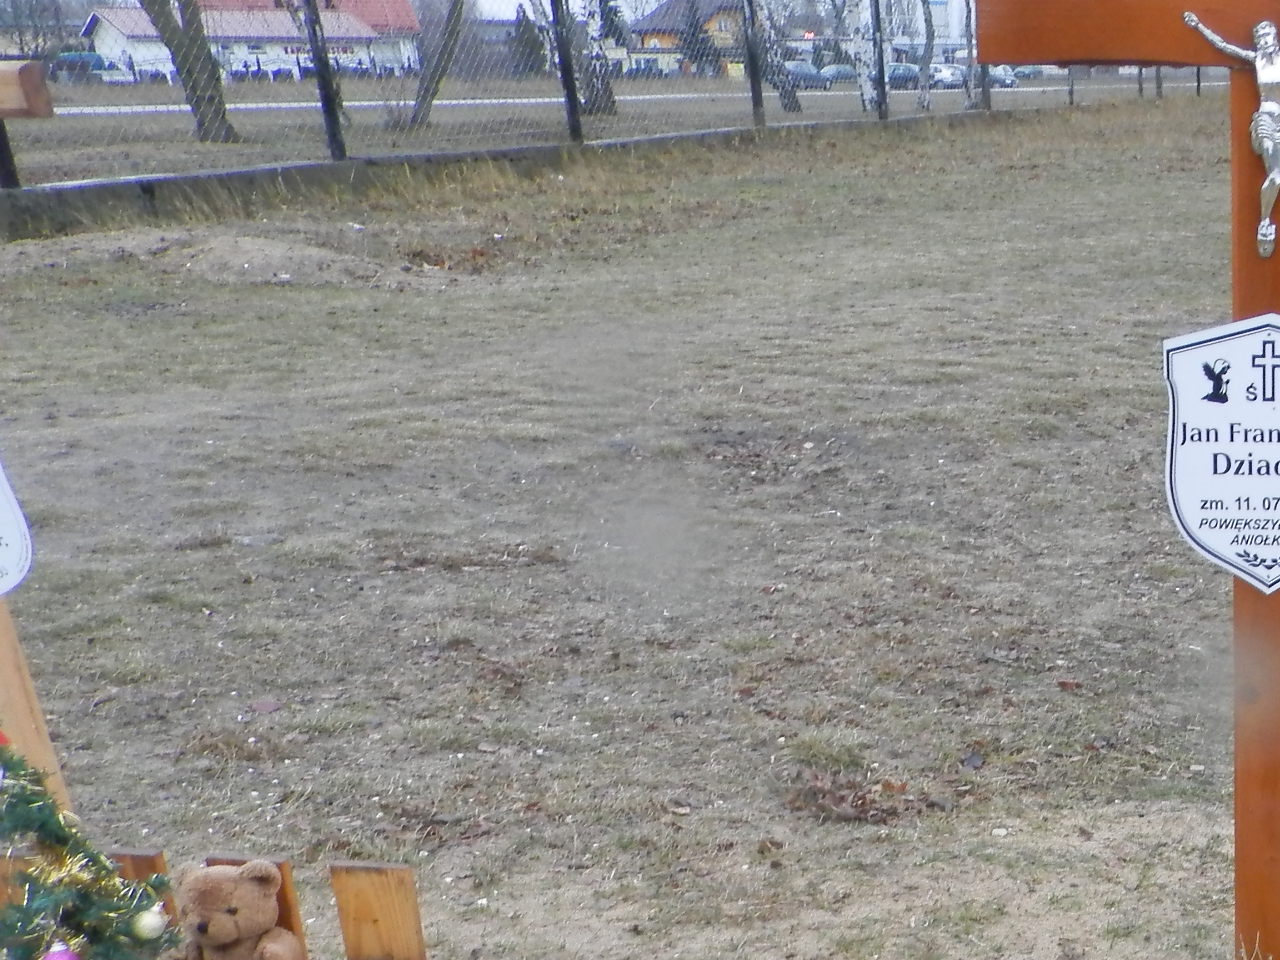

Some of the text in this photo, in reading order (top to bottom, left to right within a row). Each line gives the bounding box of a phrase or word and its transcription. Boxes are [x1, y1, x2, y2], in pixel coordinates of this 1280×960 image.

[1245, 382, 1258, 402] Ś
[1180, 422, 1219, 446] Jan
[1200, 499, 1229, 511] zm.
[1235, 497, 1257, 511] 11.
